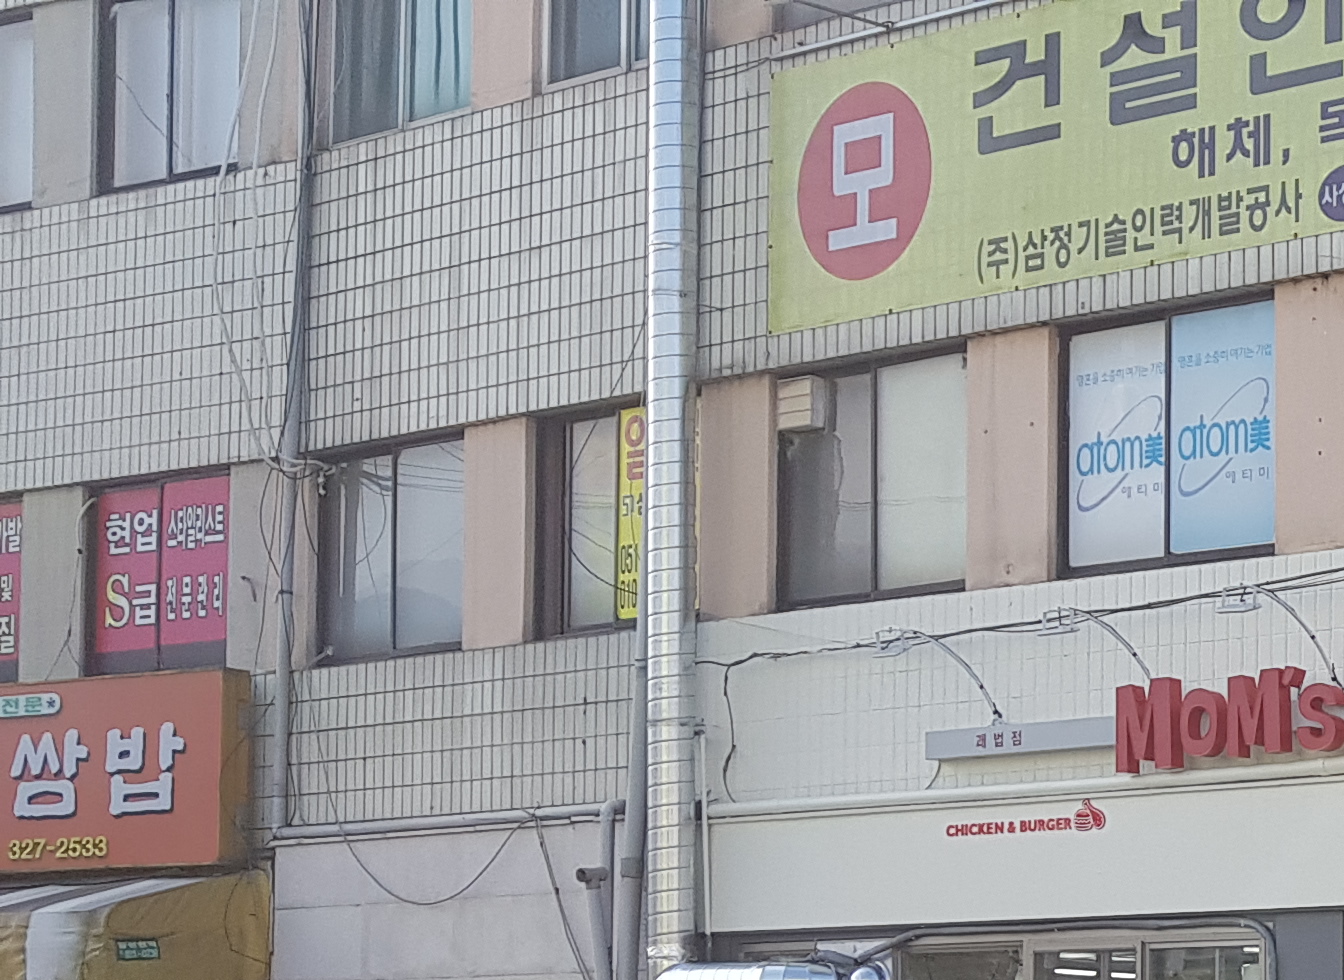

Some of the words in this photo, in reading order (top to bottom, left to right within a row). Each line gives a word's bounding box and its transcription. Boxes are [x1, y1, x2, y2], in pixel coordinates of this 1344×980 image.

[827, 112, 897, 251] 모
[976, 178, 1302, 285] (주)삼정기술인력개발공사
[106, 509, 158, 556] 현업
[167, 504, 225, 549] 스타일리스트
[8, 836, 108, 860] 327-2533
[946, 821, 1004, 837] CHICKEN
[1007, 820, 1016, 834] &
[1020, 816, 1073, 833] BURGER
